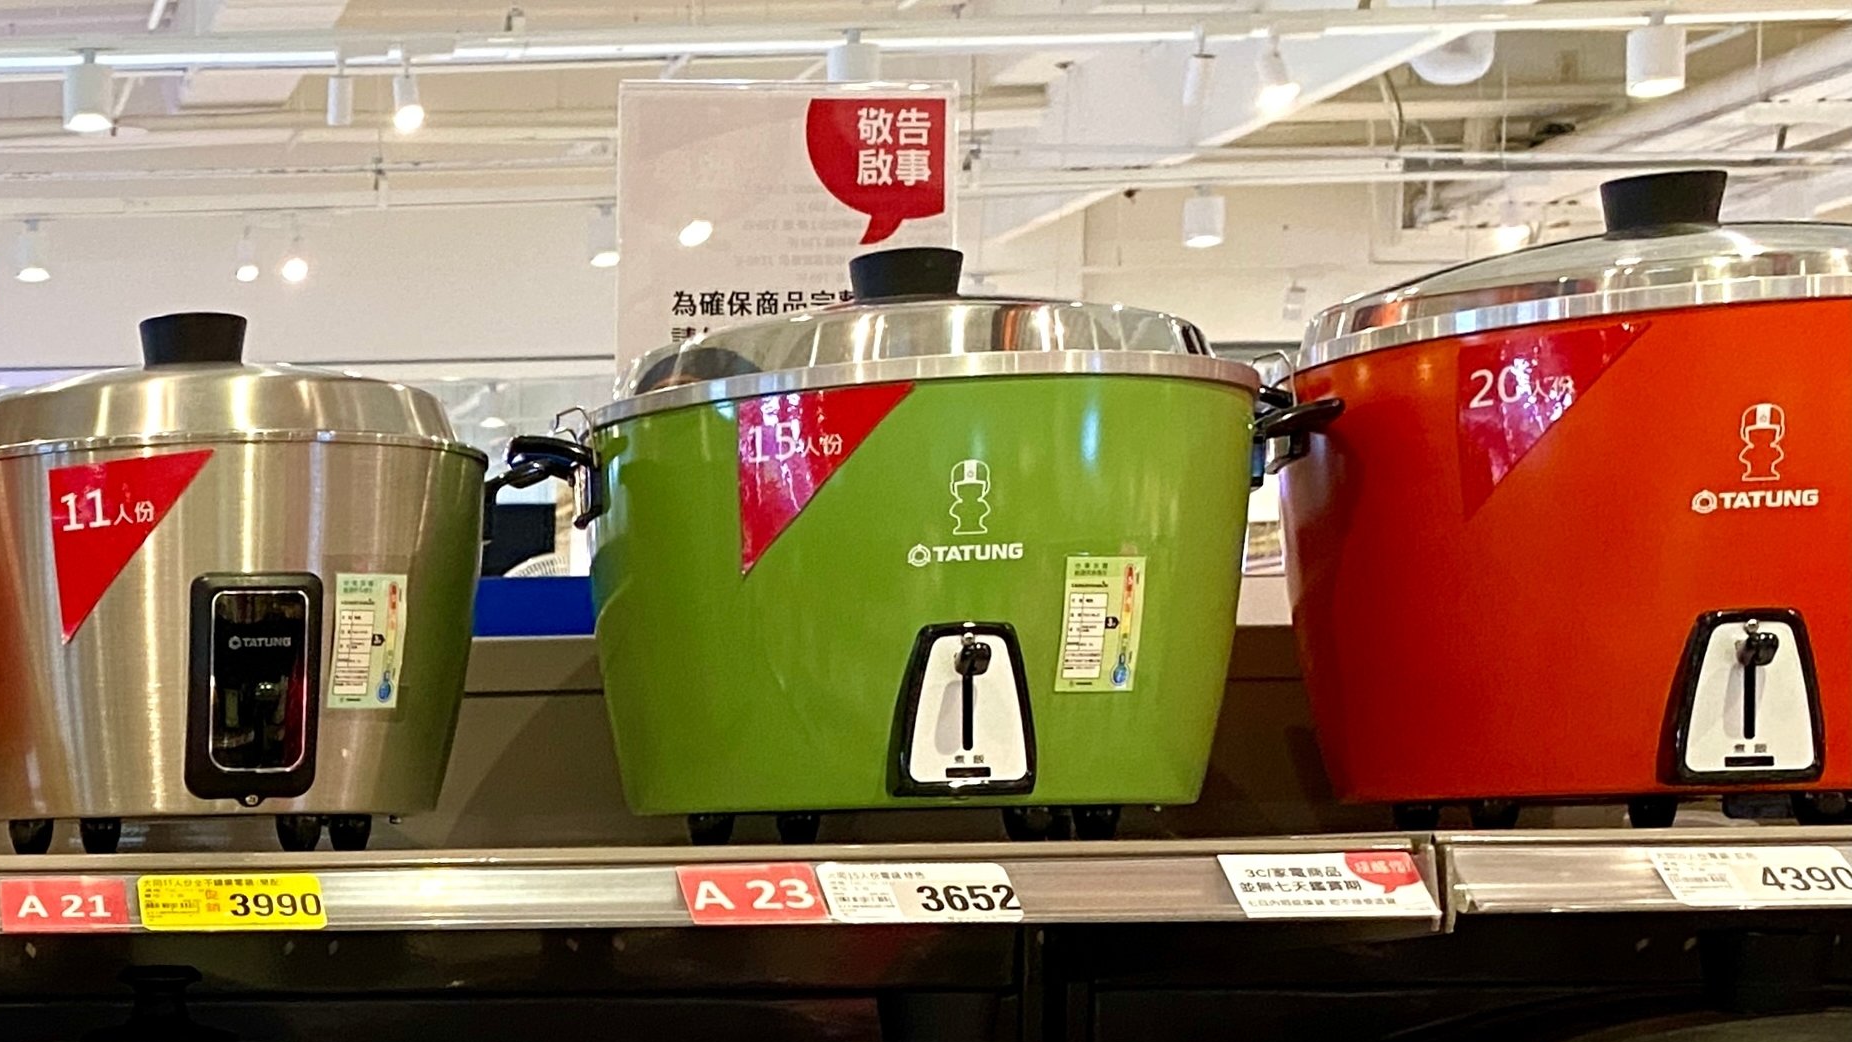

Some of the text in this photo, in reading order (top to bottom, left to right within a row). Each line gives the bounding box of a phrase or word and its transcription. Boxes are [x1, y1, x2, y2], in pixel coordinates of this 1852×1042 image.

[857, 108, 931, 145] 敬告
[857, 149, 931, 186] 啟事
[748, 422, 842, 463] 15人份
[61, 489, 155, 532] 11人份
[1718, 489, 1819, 508] TATUNG
[932, 543, 1023, 562] TATUNG
[242, 636, 291, 648] TATUNG
[1762, 866, 1852, 891] 4390
[18, 895, 112, 918] A 21
[229, 893, 321, 917] 3990
[694, 879, 816, 910] A 23
[916, 884, 1022, 912] 3652
